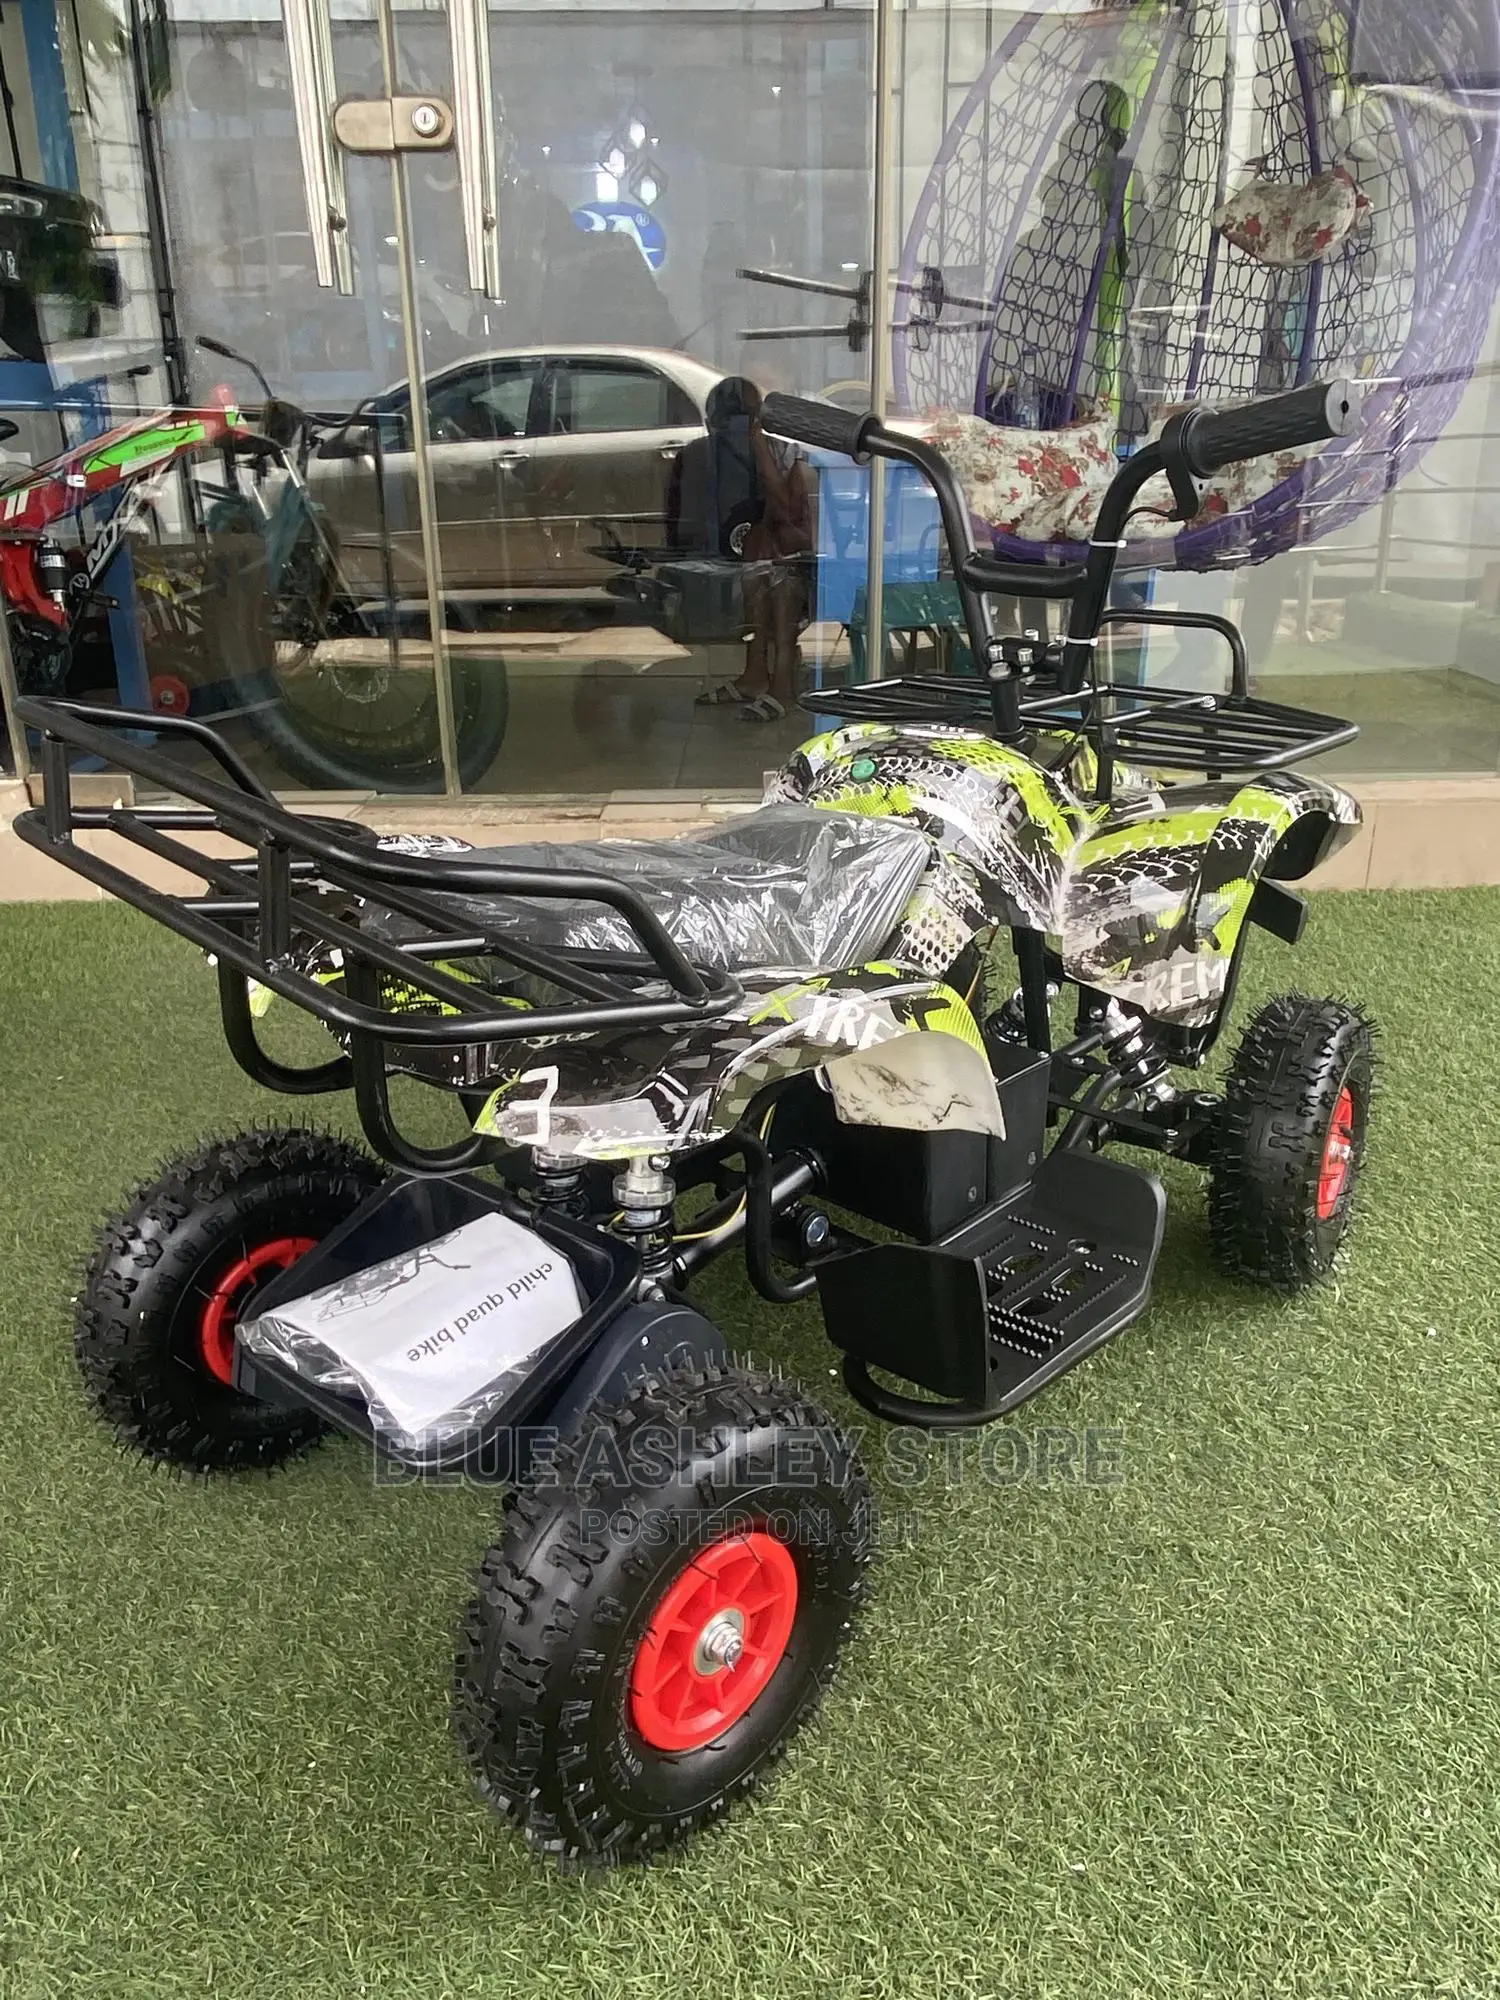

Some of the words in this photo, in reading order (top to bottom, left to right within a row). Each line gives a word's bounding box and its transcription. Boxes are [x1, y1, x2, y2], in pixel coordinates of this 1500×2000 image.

[505, 1262, 553, 1300] child
[453, 1292, 504, 1335] quad
[407, 1327, 456, 1362] bike
